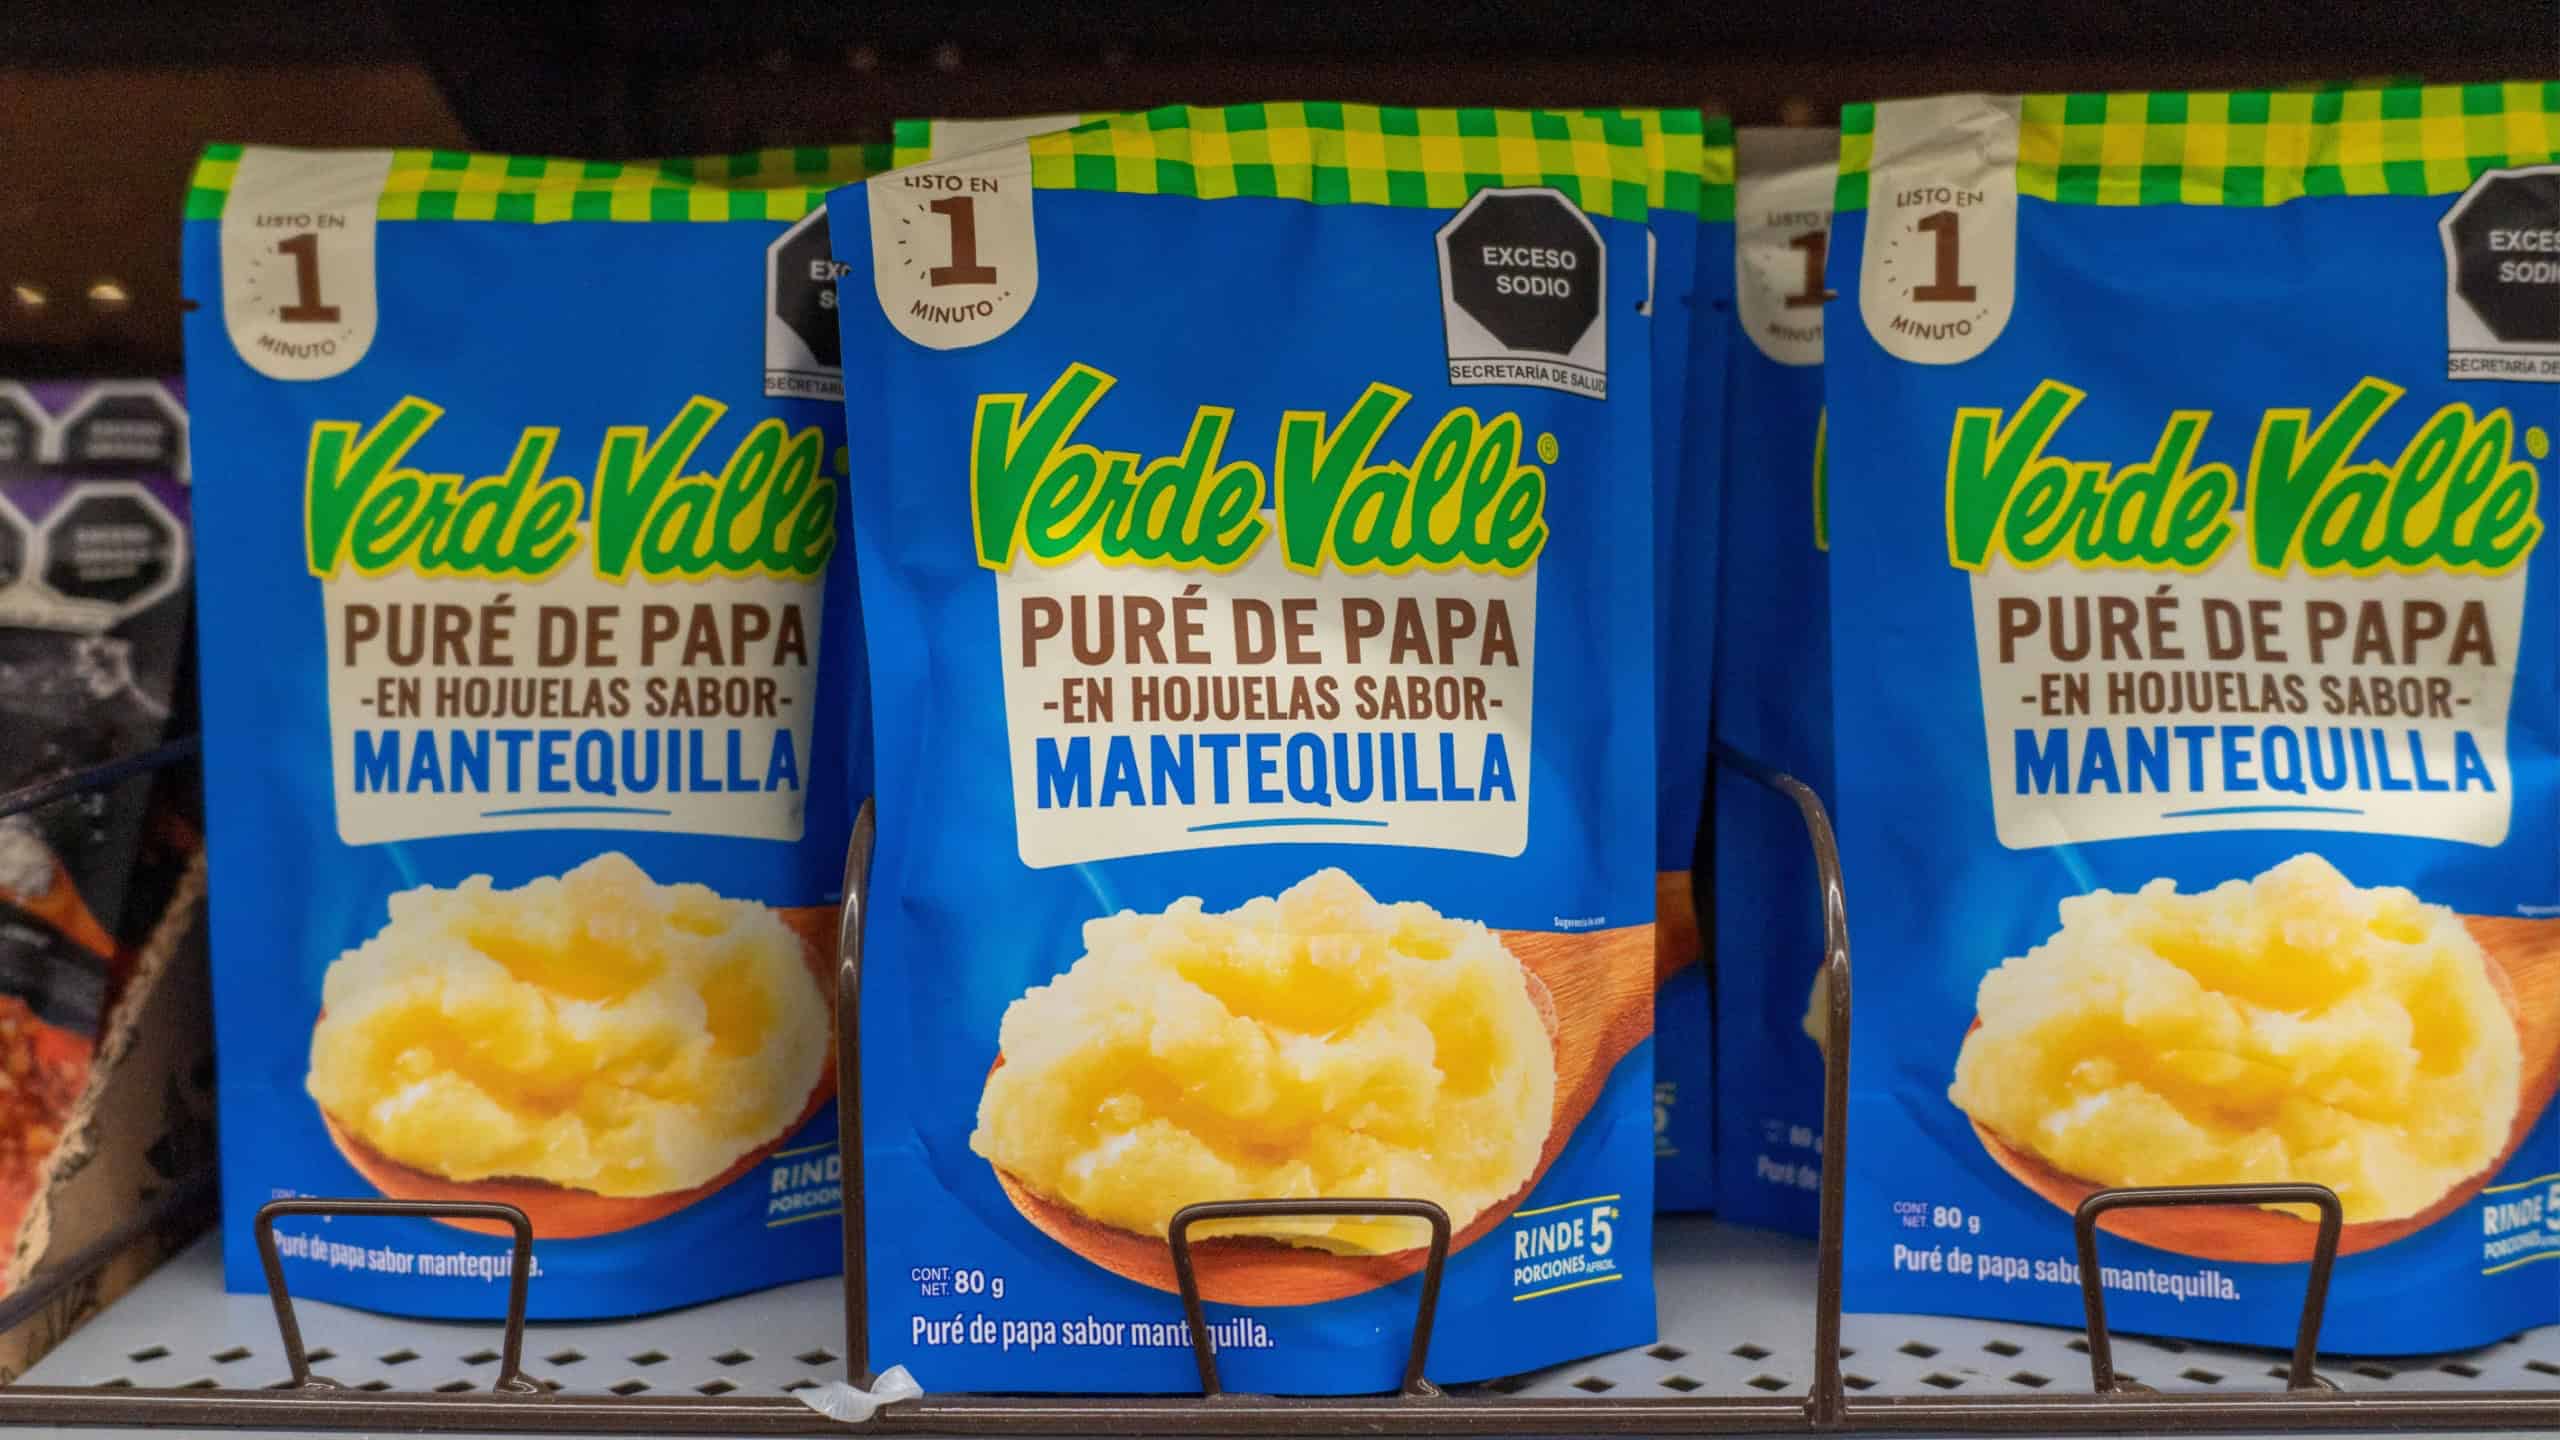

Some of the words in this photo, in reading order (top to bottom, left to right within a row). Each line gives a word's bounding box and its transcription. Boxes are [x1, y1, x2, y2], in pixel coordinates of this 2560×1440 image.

[904, 174, 963, 191] LISTO
[970, 177, 998, 192] EN
[1896, 187, 1951, 208] LISTO
[1956, 190, 1984, 207] EN
[256, 213, 311, 228] LISTO
[317, 214, 345, 228] EN
[930, 196, 996, 287] 1
[278, 233, 340, 323] 1
[1482, 247, 1577, 270] EXCESO
[1784, 229, 1838, 309] 1
[1912, 210, 1977, 302] 1
[1495, 275, 1571, 298] SODIO
[909, 300, 993, 324] MINUTO
[1889, 315, 1973, 341] MINUTO
[257, 333, 336, 359] MINUTO
[1451, 364, 1550, 381] SECRETARÍA
[1552, 368, 1568, 385] DE
[1570, 373, 1606, 394] SALUD
[306, 395, 585, 582] Verde
[595, 395, 838, 584] Valle
[970, 361, 1271, 572] Verde
[1275, 382, 1549, 578] Valle
[1946, 378, 2239, 573] Verde
[2248, 376, 2545, 578] Valle
[344, 594, 517, 667] PURÉ
[537, 606, 621, 667] DE
[641, 603, 808, 667] PAPA
[1021, 583, 1212, 667] PURÉ
[1231, 597, 1322, 665] DE
[1342, 596, 1520, 667] PAPA
[1999, 584, 2185, 664] PURÉ
[2201, 598, 2288, 662] DE
[2305, 600, 2497, 666] PAPA
[361, 677, 420, 718] -EN
[437, 677, 630, 718] HOJUELAS
[645, 677, 793, 720] SABOR-
[1043, 677, 1114, 723] -EN
[1132, 675, 1341, 721] HOJUELAS
[1355, 675, 1503, 721] SABOR-
[2021, 673, 2090, 716] -EN
[2108, 672, 2308, 715] HOJUELAS
[2320, 675, 2473, 719] SABOR-
[353, 728, 801, 797] MANTEQUILLA
[1035, 731, 1517, 808] MANTEQUILLA
[2014, 725, 2497, 795] MANTEQUILLA
[1933, 1205, 1962, 1229] 80
[1967, 1214, 1981, 1235] g
[2484, 1195, 2542, 1235] RINDE
[271, 1228, 309, 1257] Puré
[310, 1234, 329, 1261] de
[330, 1242, 365, 1269] papa
[367, 1245, 414, 1274] sabor
[418, 1248, 544, 1284] mantequia.
[1514, 1217, 1585, 1261] RINDE
[911, 1267, 950, 1281] CONT.
[921, 1282, 950, 1297] NET.
[954, 1269, 985, 1295] 80
[991, 1276, 1005, 1299] g
[1513, 1253, 1586, 1286] PORCIONES
[1894, 1243, 1943, 1273] Puré
[1946, 1247, 1974, 1274] de
[1977, 1254, 2030, 1283] papa
[2034, 1256, 2083, 1286] sabo
[2101, 1265, 2241, 1302] mantequilla.
[911, 1313, 964, 1345] Puré
[969, 1313, 997, 1345] de
[1002, 1319, 1057, 1351] papa
[1062, 1315, 1126, 1346] sabor
[1131, 1317, 1275, 1355] mantquilla.
